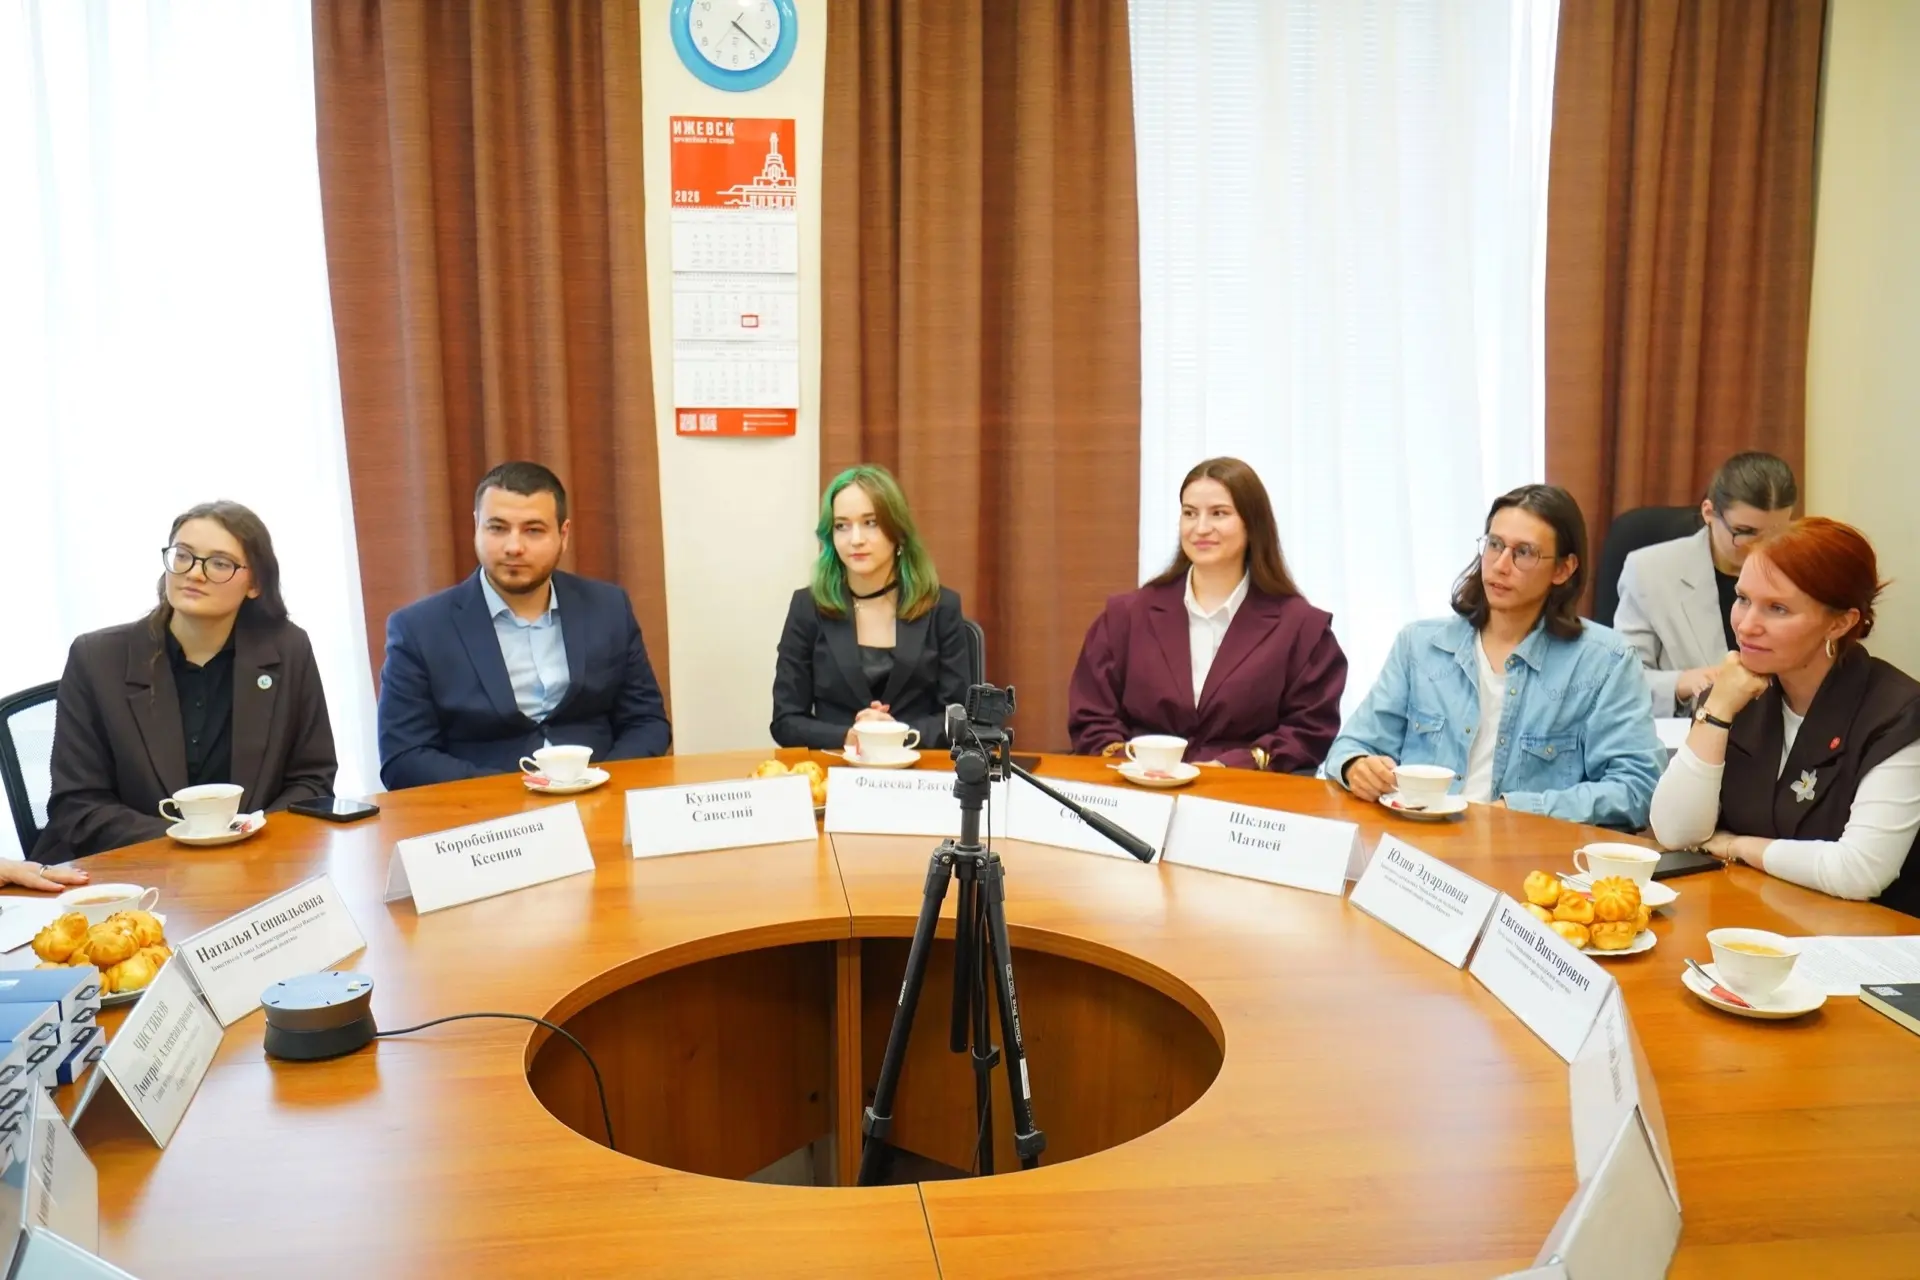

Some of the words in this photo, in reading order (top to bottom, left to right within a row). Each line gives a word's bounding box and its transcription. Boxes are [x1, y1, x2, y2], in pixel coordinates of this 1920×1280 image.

[673, 120, 735, 137] ИЖЕВСК
[855, 776, 912, 790] Фадеева
[685, 791, 752, 807] Кузнецов
[692, 806, 753, 823] Савелий
[1230, 811, 1286, 832] Шкляев
[435, 822, 545, 855] Коробейникова
[1228, 830, 1281, 852] Матвей
[470, 847, 522, 867] Ксения
[1387, 847, 1415, 873] Юлия
[1415, 863, 1469, 905] Эдуардовна
[195, 929, 253, 964] Наталья
[251, 893, 325, 936] Геннадьевна
[1500, 907, 1537, 947] Евгений
[1534, 936, 1590, 992] Викторович
[133, 1000, 169, 1052] ЧИСТЯКОВ
[133, 1052, 164, 1104] Дмитрий
[158, 1000, 196, 1059] Александрович
